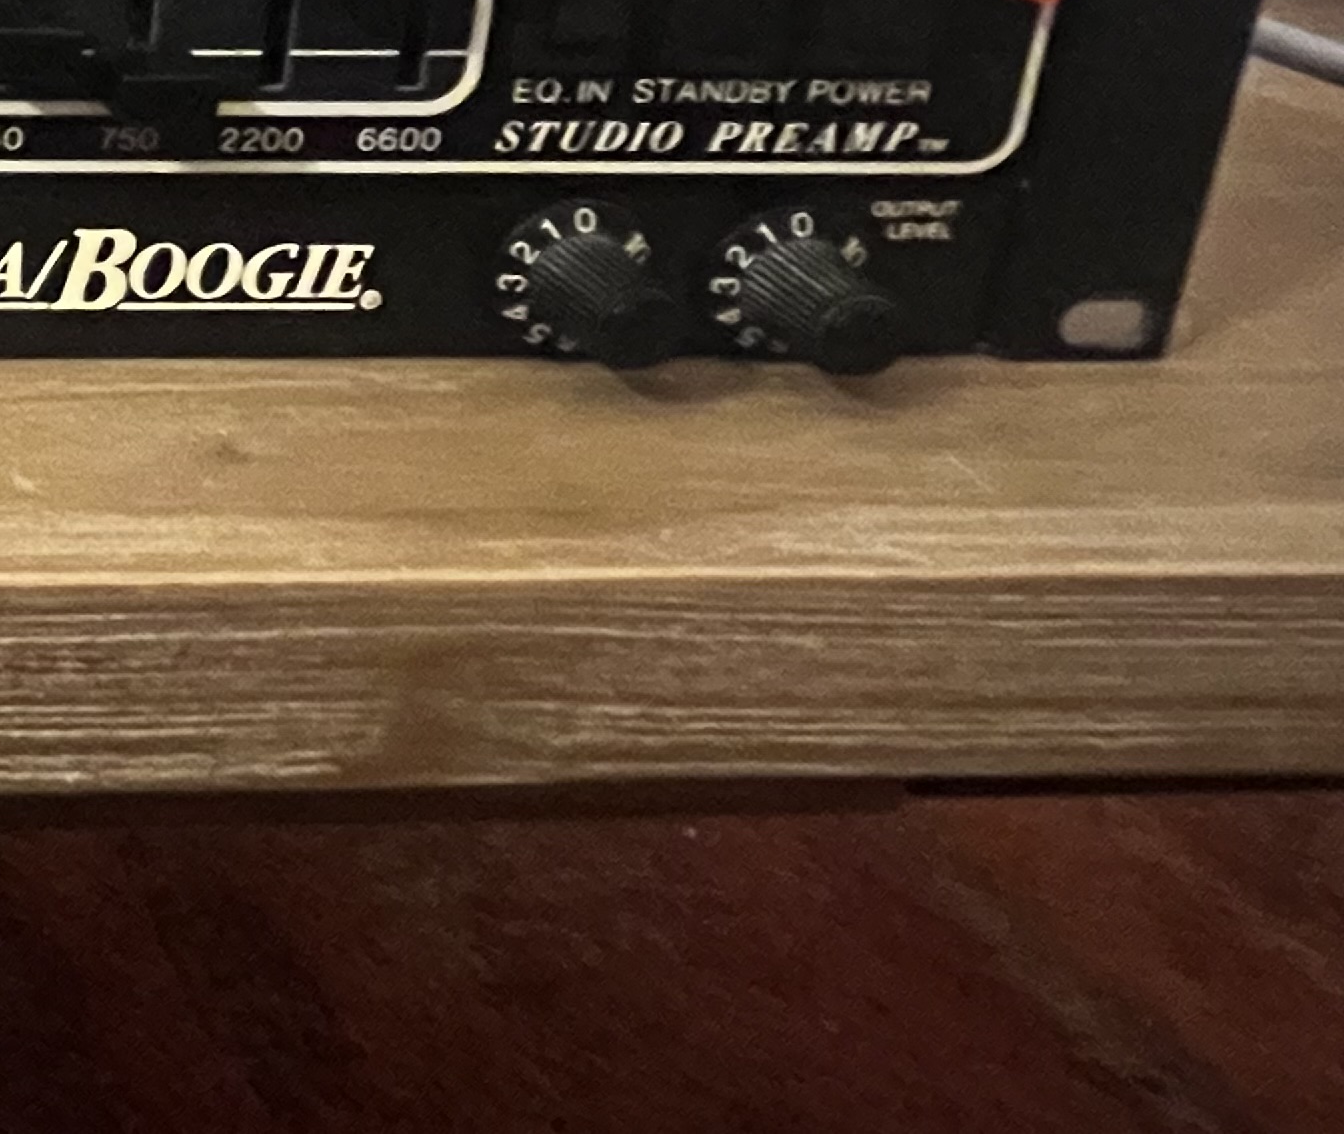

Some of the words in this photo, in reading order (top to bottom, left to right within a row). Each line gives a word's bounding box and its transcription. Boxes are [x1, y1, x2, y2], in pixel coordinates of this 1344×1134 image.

[632, 79, 797, 104] STANDBY
[806, 79, 932, 104] POWER
[100, 126, 159, 151] 750
[219, 126, 304, 151] 2200
[356, 126, 443, 151] 6600
[494, 120, 685, 152] STUDIO
[540, 218, 562, 240] 1
[573, 207, 598, 233] 0
[790, 212, 814, 238] 0
[757, 222, 778, 243] 1
[509, 241, 541, 265] 2
[725, 245, 755, 269] 2
[496, 273, 528, 293] 3
[710, 277, 741, 296] 3
